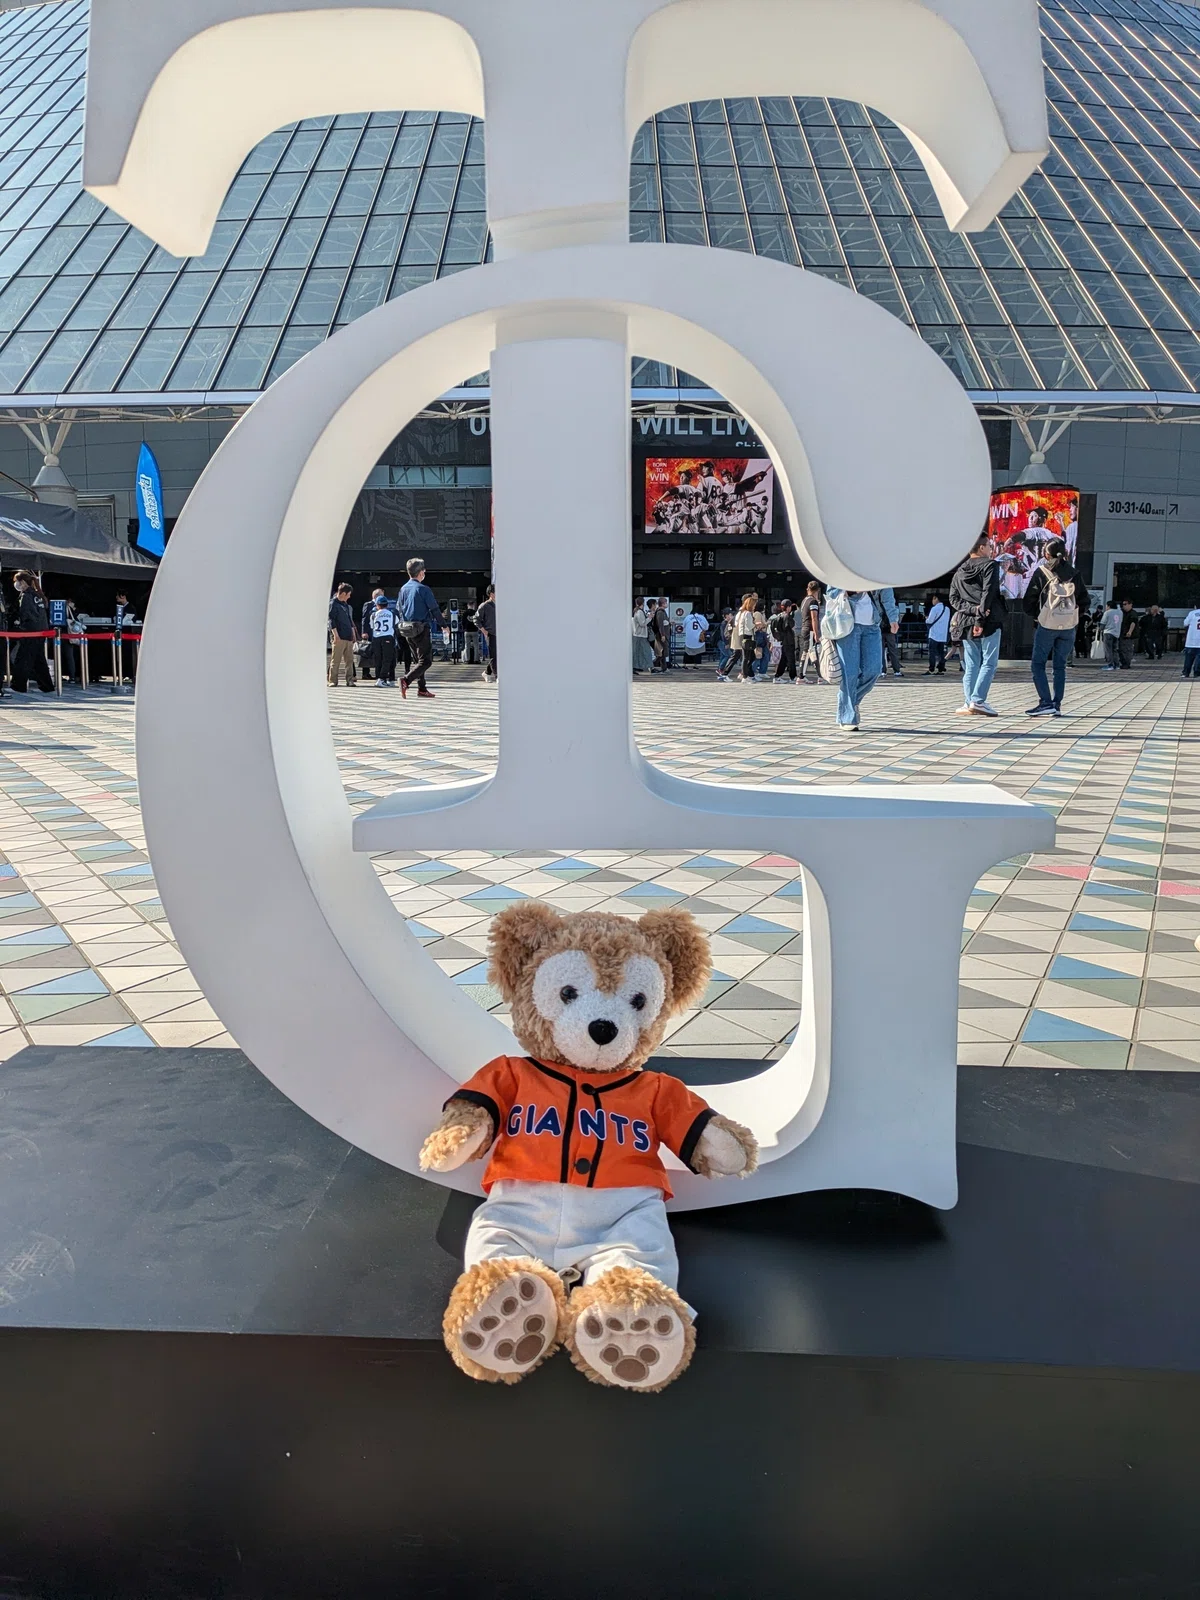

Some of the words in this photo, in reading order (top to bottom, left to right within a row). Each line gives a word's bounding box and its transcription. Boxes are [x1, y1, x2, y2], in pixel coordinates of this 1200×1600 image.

[640, 417, 703, 435] WILL
[711, 418, 759, 436] LIV
[650, 473, 669, 481] WIN
[991, 503, 1018, 519] WIN
[693, 551, 702, 561] 22
[54, 601, 63, 621] 出口
[375, 619, 389, 632] 25
[692, 621, 699, 630] 6
[507, 1103, 651, 1152] GIANTS
